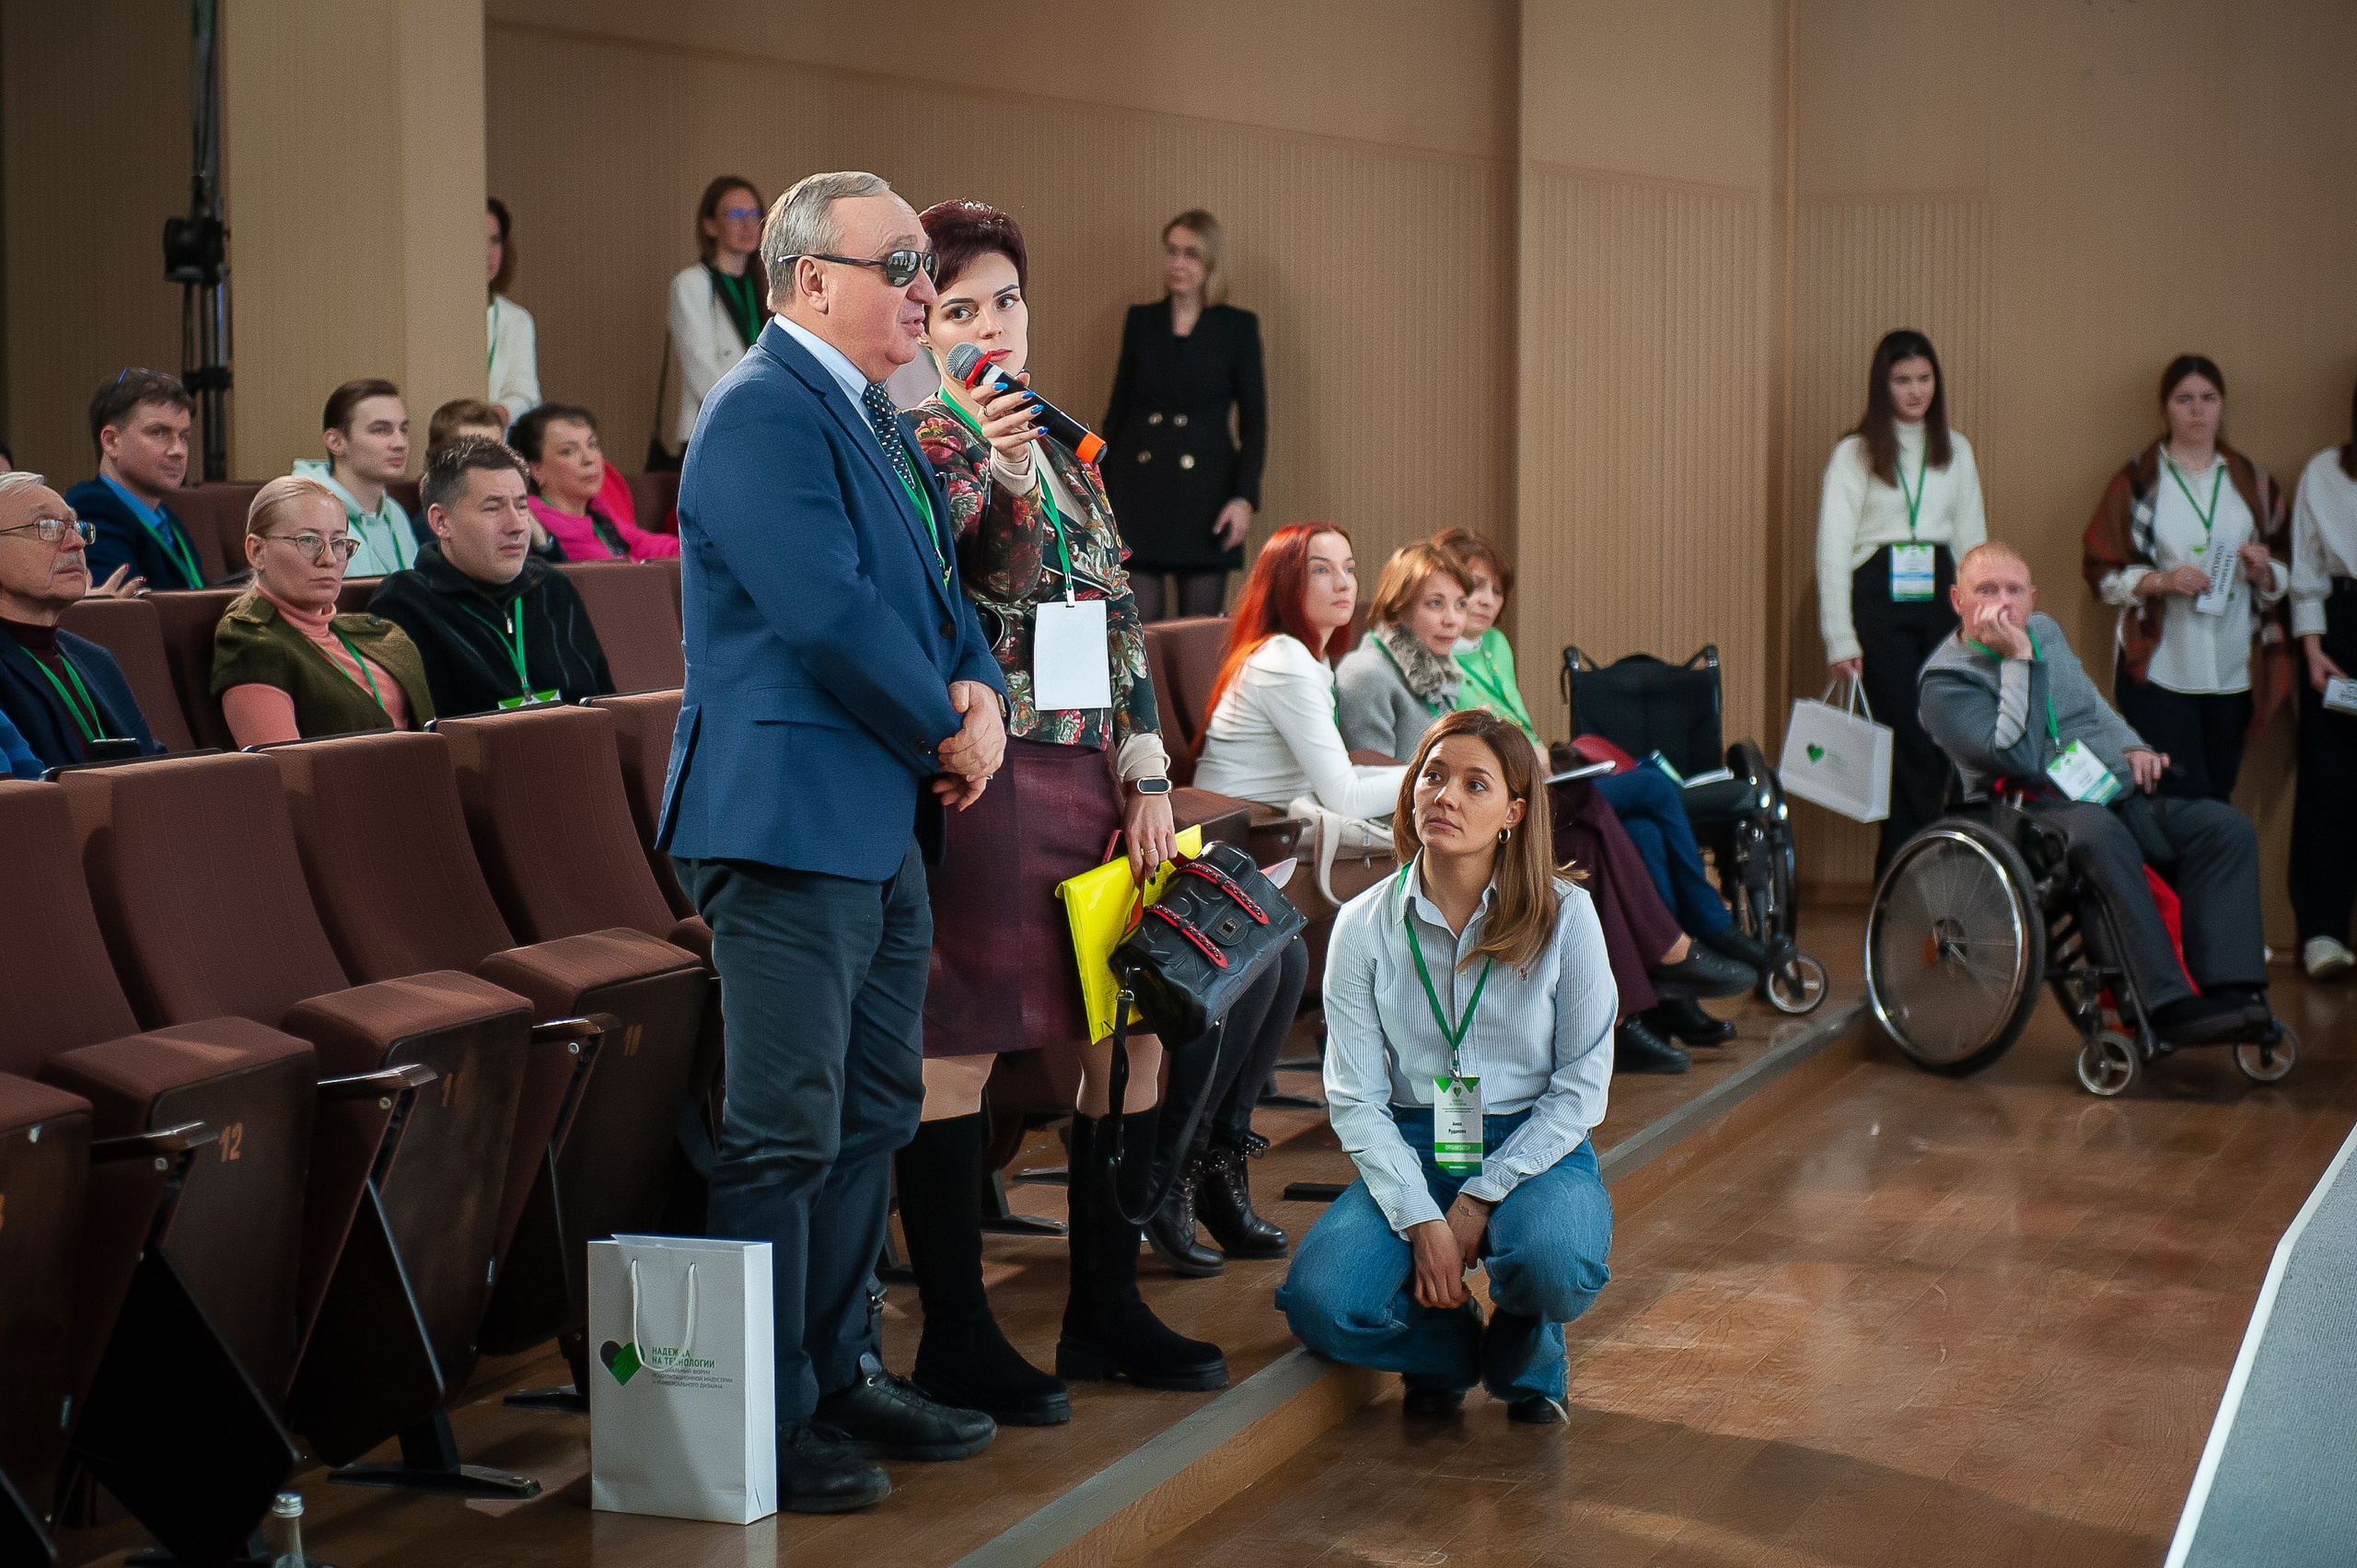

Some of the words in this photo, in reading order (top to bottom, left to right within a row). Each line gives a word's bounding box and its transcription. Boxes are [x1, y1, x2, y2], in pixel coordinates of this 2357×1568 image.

[219, 1122, 243, 1162] 12
[652, 1346, 691, 1357] НАДЕЖА
[652, 1356, 662, 1365] НА
[665, 1357, 715, 1368] ТЕНОЛОГИИ
